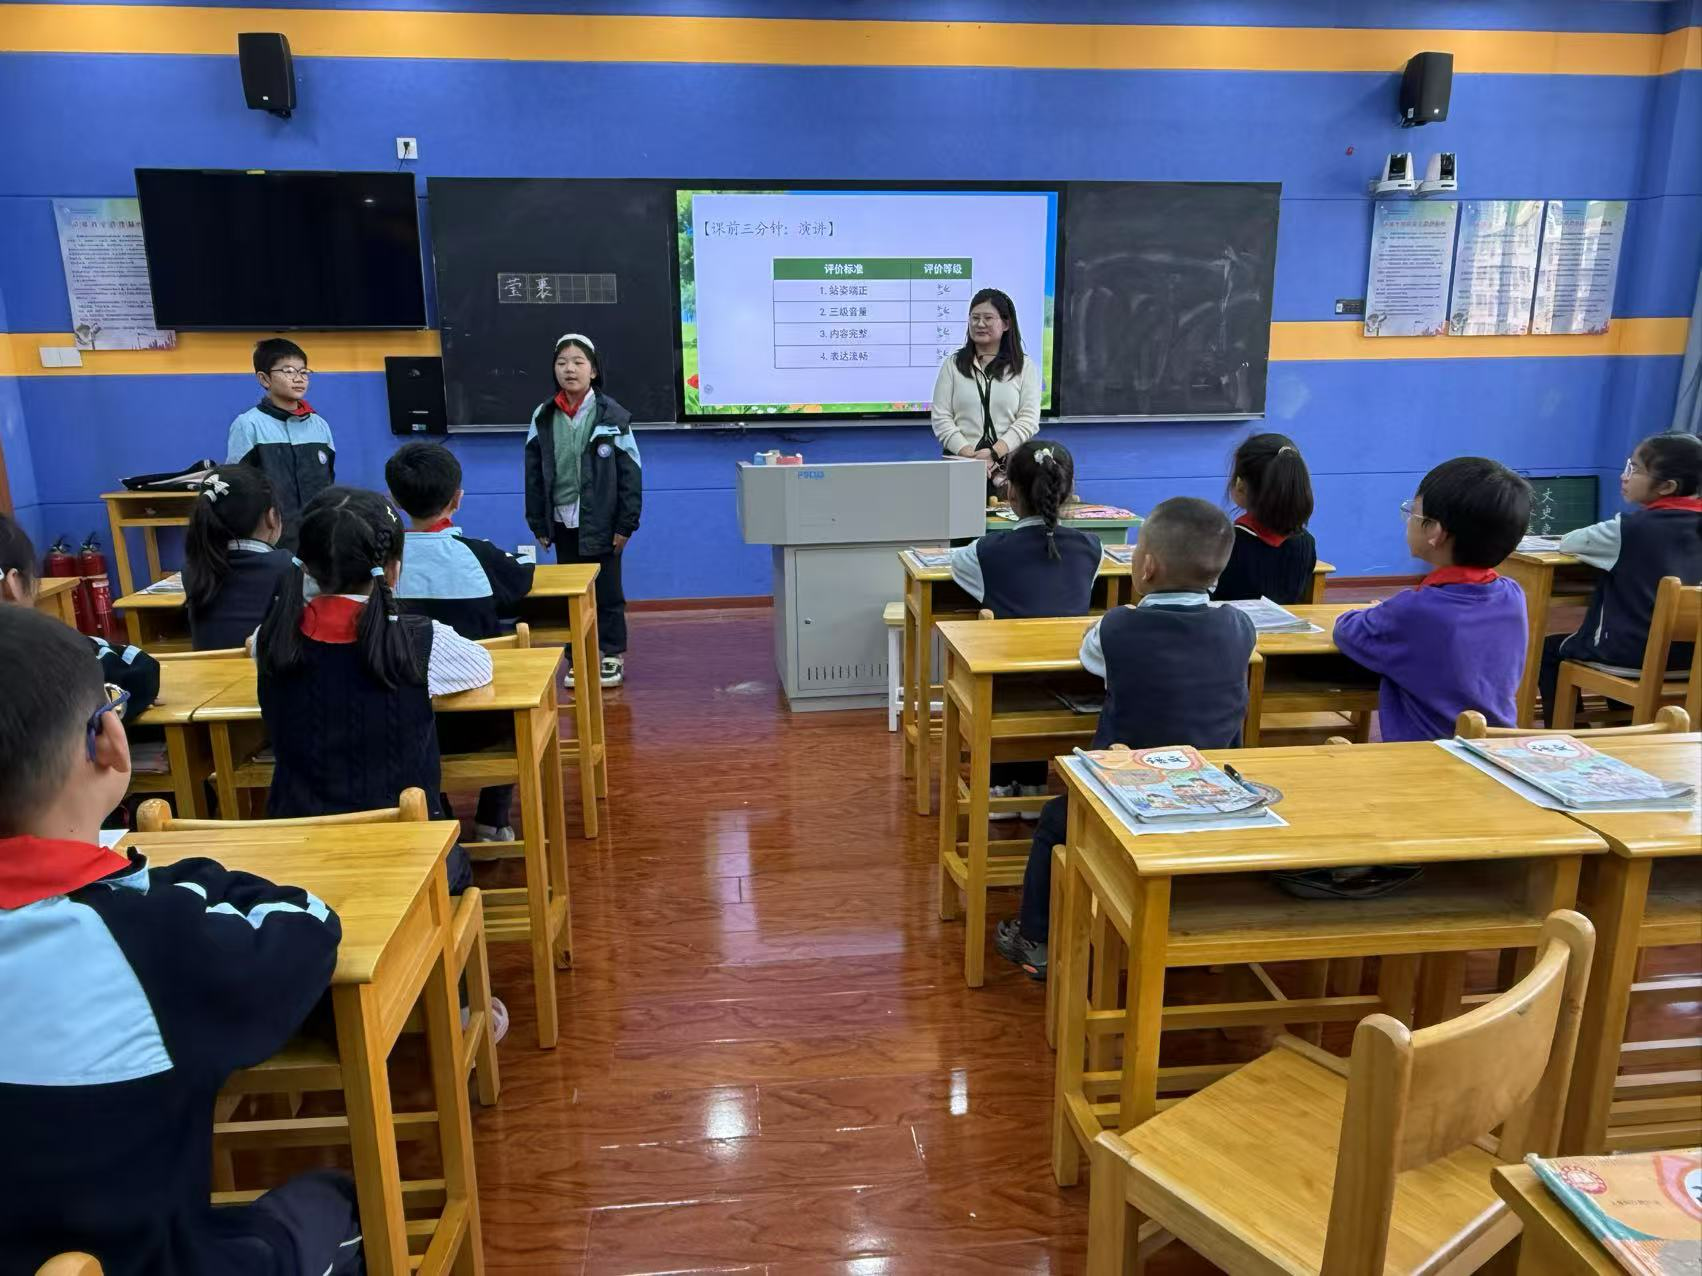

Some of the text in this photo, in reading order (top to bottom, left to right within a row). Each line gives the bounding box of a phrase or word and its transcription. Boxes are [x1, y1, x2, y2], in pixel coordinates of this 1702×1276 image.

[824, 263, 864, 275] 评价标准
[924, 263, 963, 275] 评价等级
